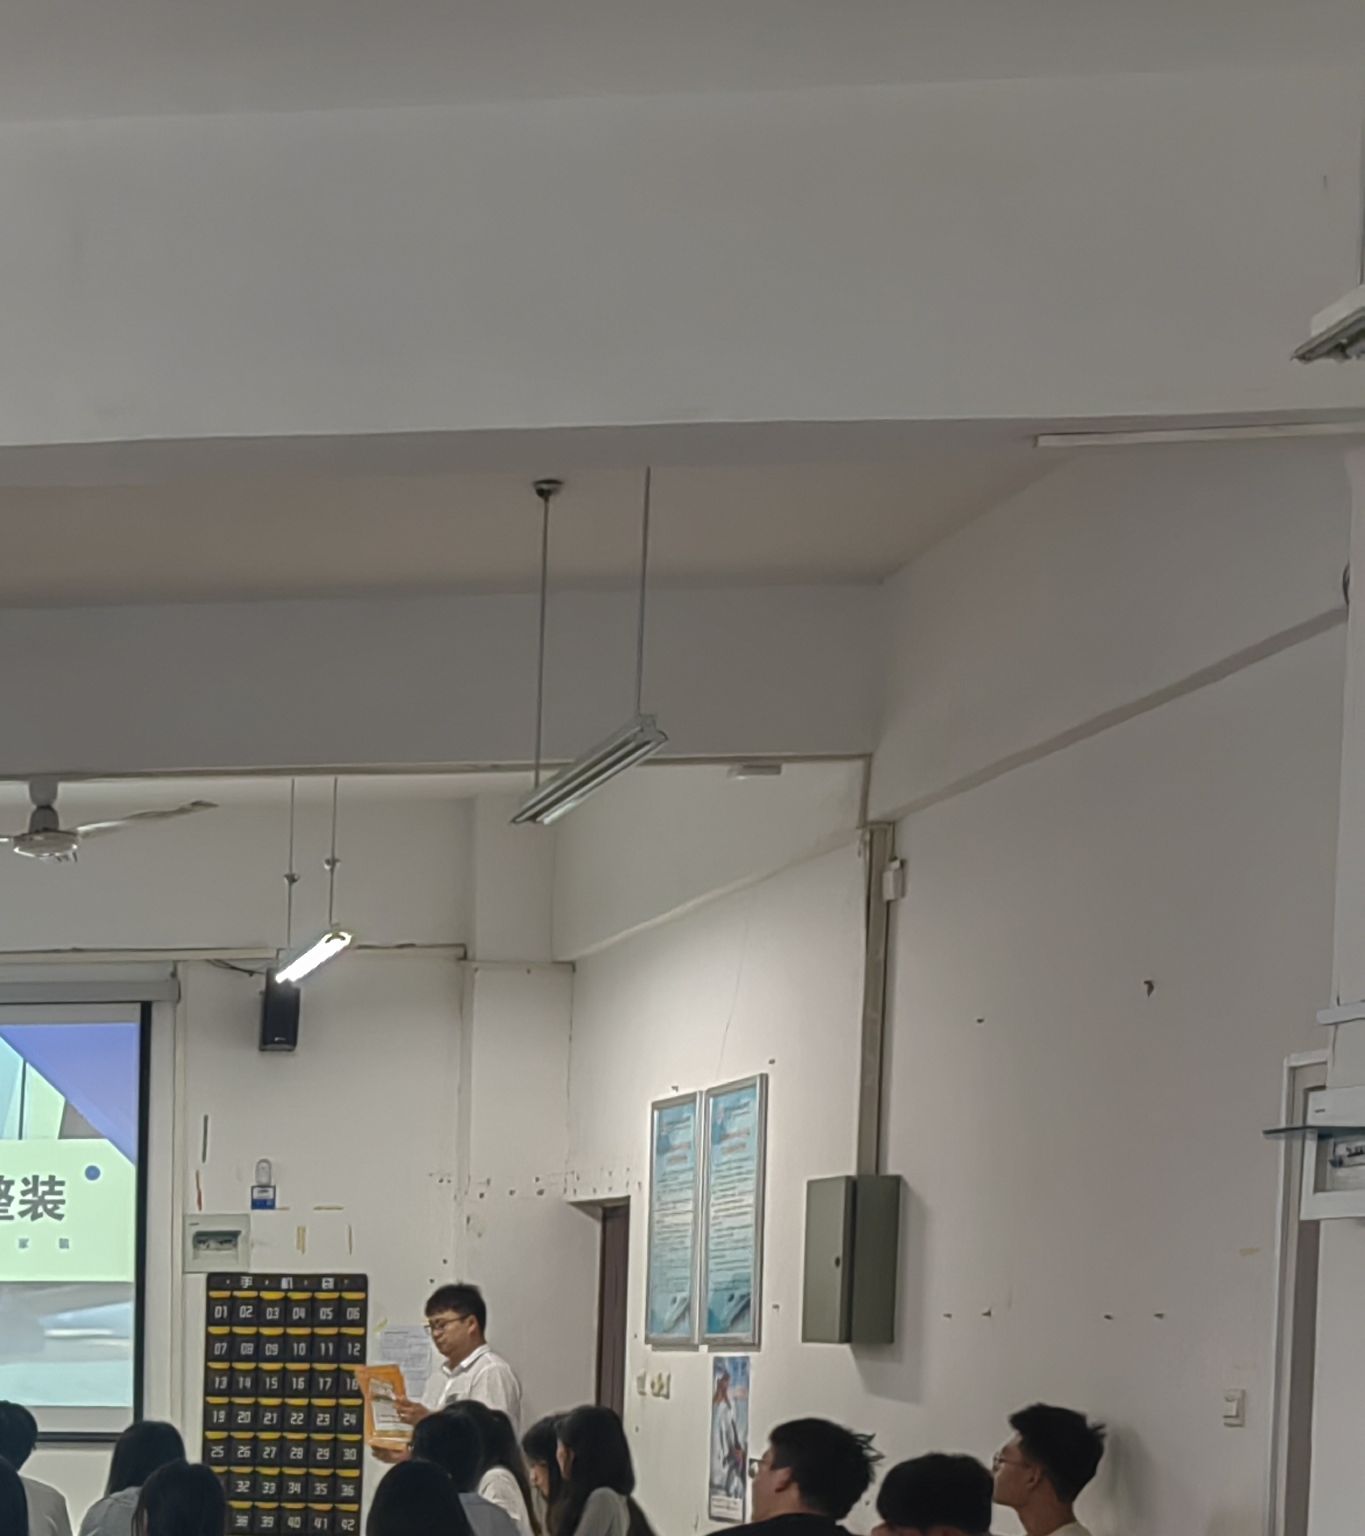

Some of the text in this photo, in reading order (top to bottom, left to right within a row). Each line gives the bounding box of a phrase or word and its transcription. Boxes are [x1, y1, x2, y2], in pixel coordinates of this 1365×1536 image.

[215, 1306, 227, 1318] 01
[240, 1305, 253, 1318] 02
[266, 1307, 279, 1319] 03
[320, 1308, 333, 1319] 05
[347, 1308, 360, 1320] 06
[214, 1343, 227, 1355] 07
[265, 1344, 278, 1355] 09
[293, 1343, 306, 1355] 10
[320, 1343, 333, 1355] 11
[348, 1343, 360, 1355] 12
[215, 1377, 227, 1389] 13
[266, 1377, 277, 1389] 15
[293, 1377, 304, 1389] 16
[319, 1378, 332, 1390] 17
[214, 1411, 225, 1423] 19
[237, 1411, 251, 1423] 20
[263, 1412, 277, 1424] 21
[290, 1413, 304, 1424] 22
[316, 1414, 330, 1425] 23
[211, 1446, 224, 1457] 25
[263, 1447, 276, 1458] 27
[343, 1448, 356, 1460] 30
[236, 1481, 250, 1492] 32
[263, 1482, 276, 1494] 33
[288, 1482, 301, 1494] 34
[314, 1483, 327, 1495] 35
[261, 1516, 274, 1527] 39
[314, 1518, 327, 1529] 41
